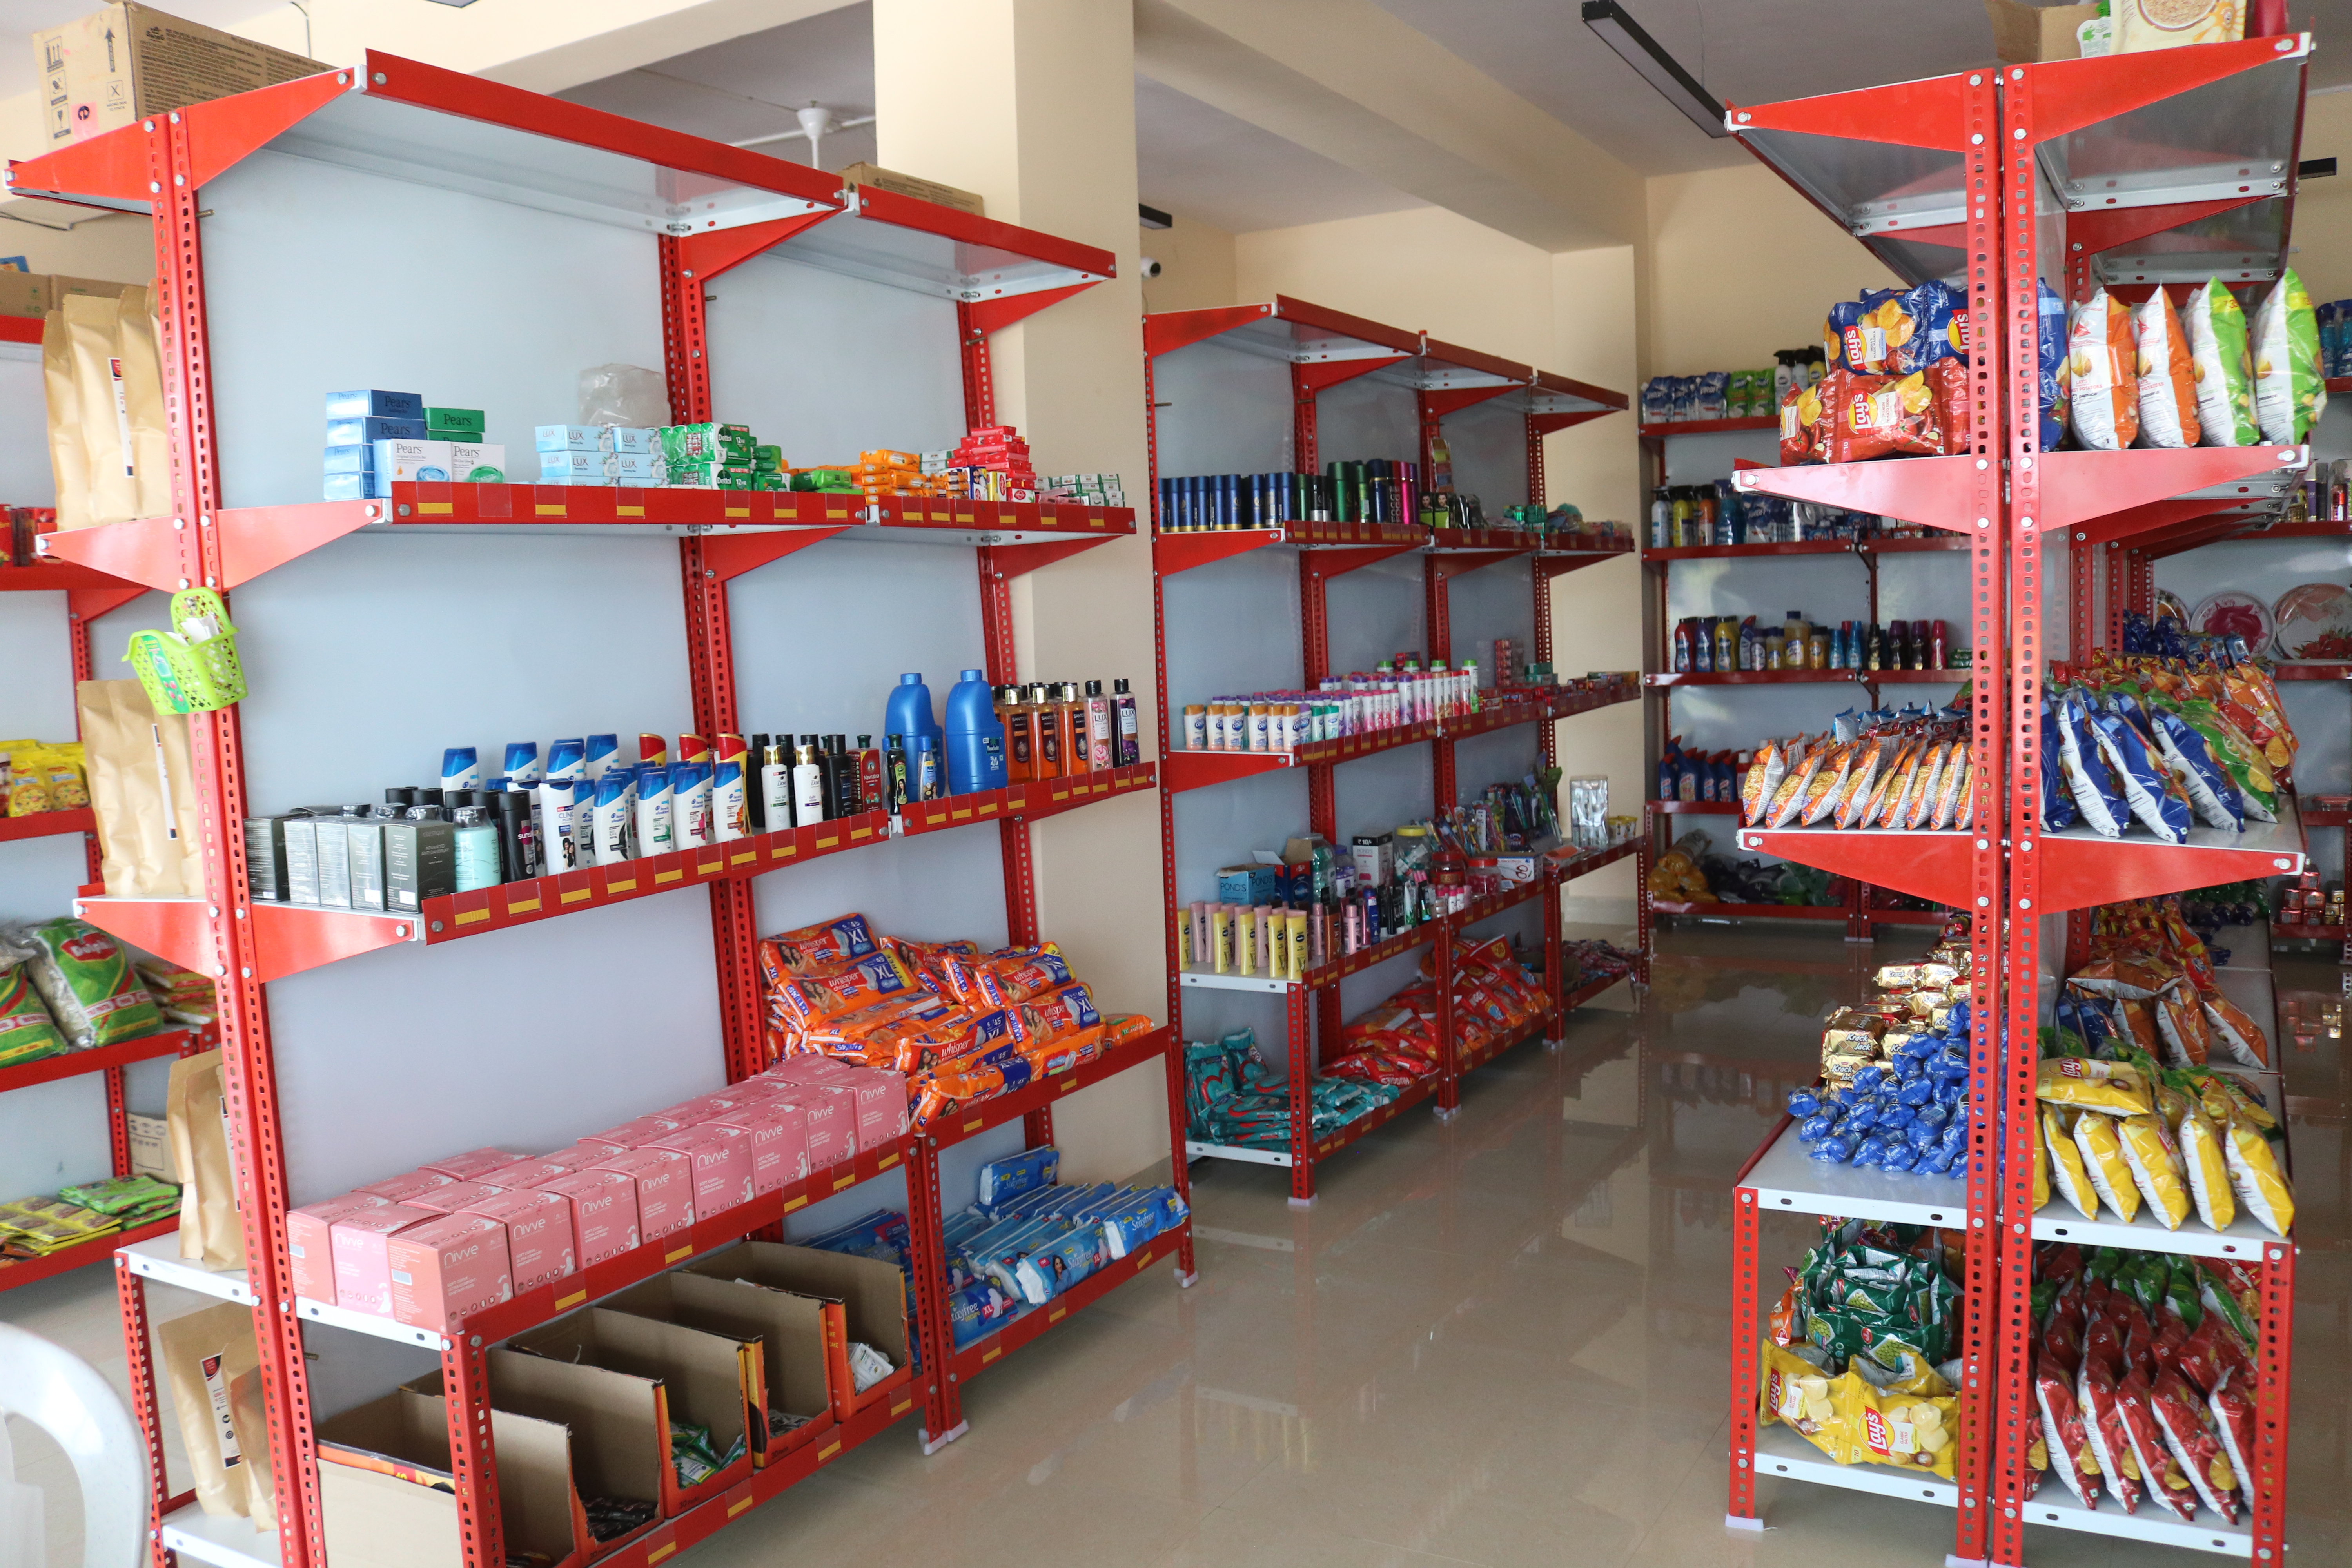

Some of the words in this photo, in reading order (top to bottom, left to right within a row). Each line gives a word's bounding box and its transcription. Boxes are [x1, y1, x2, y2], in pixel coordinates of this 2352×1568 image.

[1847, 330, 1862, 365] Lay's
[384, 396, 411, 408] Pears
[1855, 394, 1871, 430] Lay's
[443, 414, 472, 426] Pears
[381, 422, 410, 435] Pears
[569, 432, 584, 440] LUX
[623, 434, 637, 443] LUX
[396, 443, 423, 454] Pears
[454, 446, 480, 457] Pears
[573, 457, 589, 466] LUX
[622, 460, 637, 468] LUX
[1221, 882, 1247, 892] POND'S
[1252, 875, 1273, 886] POND'S
[799, 936, 827, 950] whisper
[849, 928, 868, 945] XL
[875, 964, 894, 979] XL
[1014, 967, 1038, 981] whisper
[828, 972, 858, 987] whisper
[1044, 1004, 1066, 1017] whisper
[1935, 1017, 1949, 1026] Kra
[1846, 1033, 1869, 1042] Krack
[942, 1040, 969, 1057] whisper
[1853, 1043, 1871, 1051] Jack
[1832, 1065, 1853, 1073] Krack
[861, 1086, 886, 1102] nivve
[808, 1105, 834, 1122] nivve
[755, 1125, 783, 1143] nivve
[697, 1149, 730, 1168] nivve
[642, 1174, 670, 1191] nivve
[582, 1196, 613, 1214] nivve
[514, 1218, 546, 1238] nivve
[1132, 1211, 1155, 1231] Stayfree
[336, 1233, 363, 1248] nivve
[444, 1245, 479, 1266] nivve
[1067, 1249, 1093, 1270] Stayfree
[983, 1305, 993, 1314] XL
[1769, 1373, 1781, 1411] Lay's
[1867, 1412, 1887, 1450] Lay's
[679, 1498, 687, 1508] 30
[589, 1550, 597, 1560] 30
